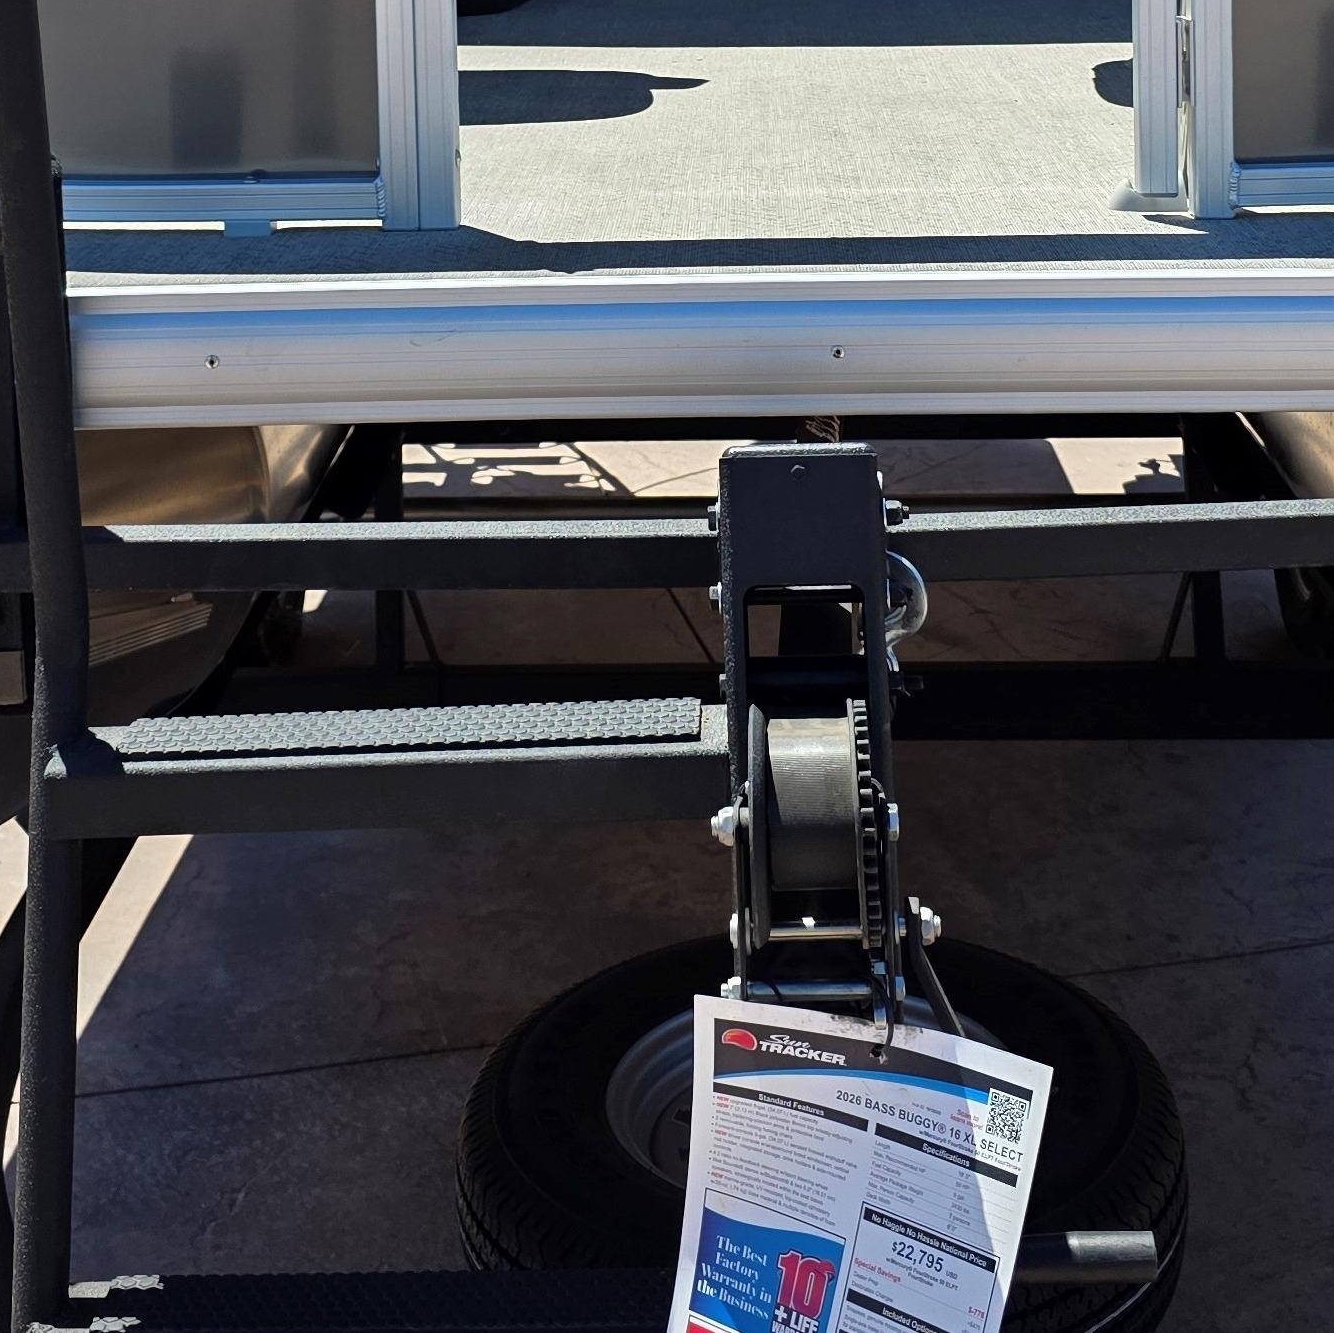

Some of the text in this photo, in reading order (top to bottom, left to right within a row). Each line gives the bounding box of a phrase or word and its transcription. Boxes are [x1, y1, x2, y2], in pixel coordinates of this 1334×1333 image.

[759, 1041, 847, 1066] TRACKER
[765, 1034, 810, 1049] Sun
[758, 1093, 792, 1109] Standard
[793, 1101, 825, 1116] Features
[836, 1090, 862, 1107] 2026
[864, 1097, 896, 1117] BASS
[949, 1126, 961, 1140] 16
[963, 1129, 977, 1147] XL
[980, 1138, 1024, 1163] SELECT
[922, 1142, 971, 1167] Specifications
[716, 1234, 768, 1267] The Best
[871, 1213, 987, 1267] No Haggle No Hassle National Price
[715, 1251, 760, 1283] Factory
[892, 1241, 945, 1273] $22,795
[701, 1262, 772, 1304] Warranty in
[697, 1279, 769, 1320] the Business
[911, 1317, 938, 1333] Option
